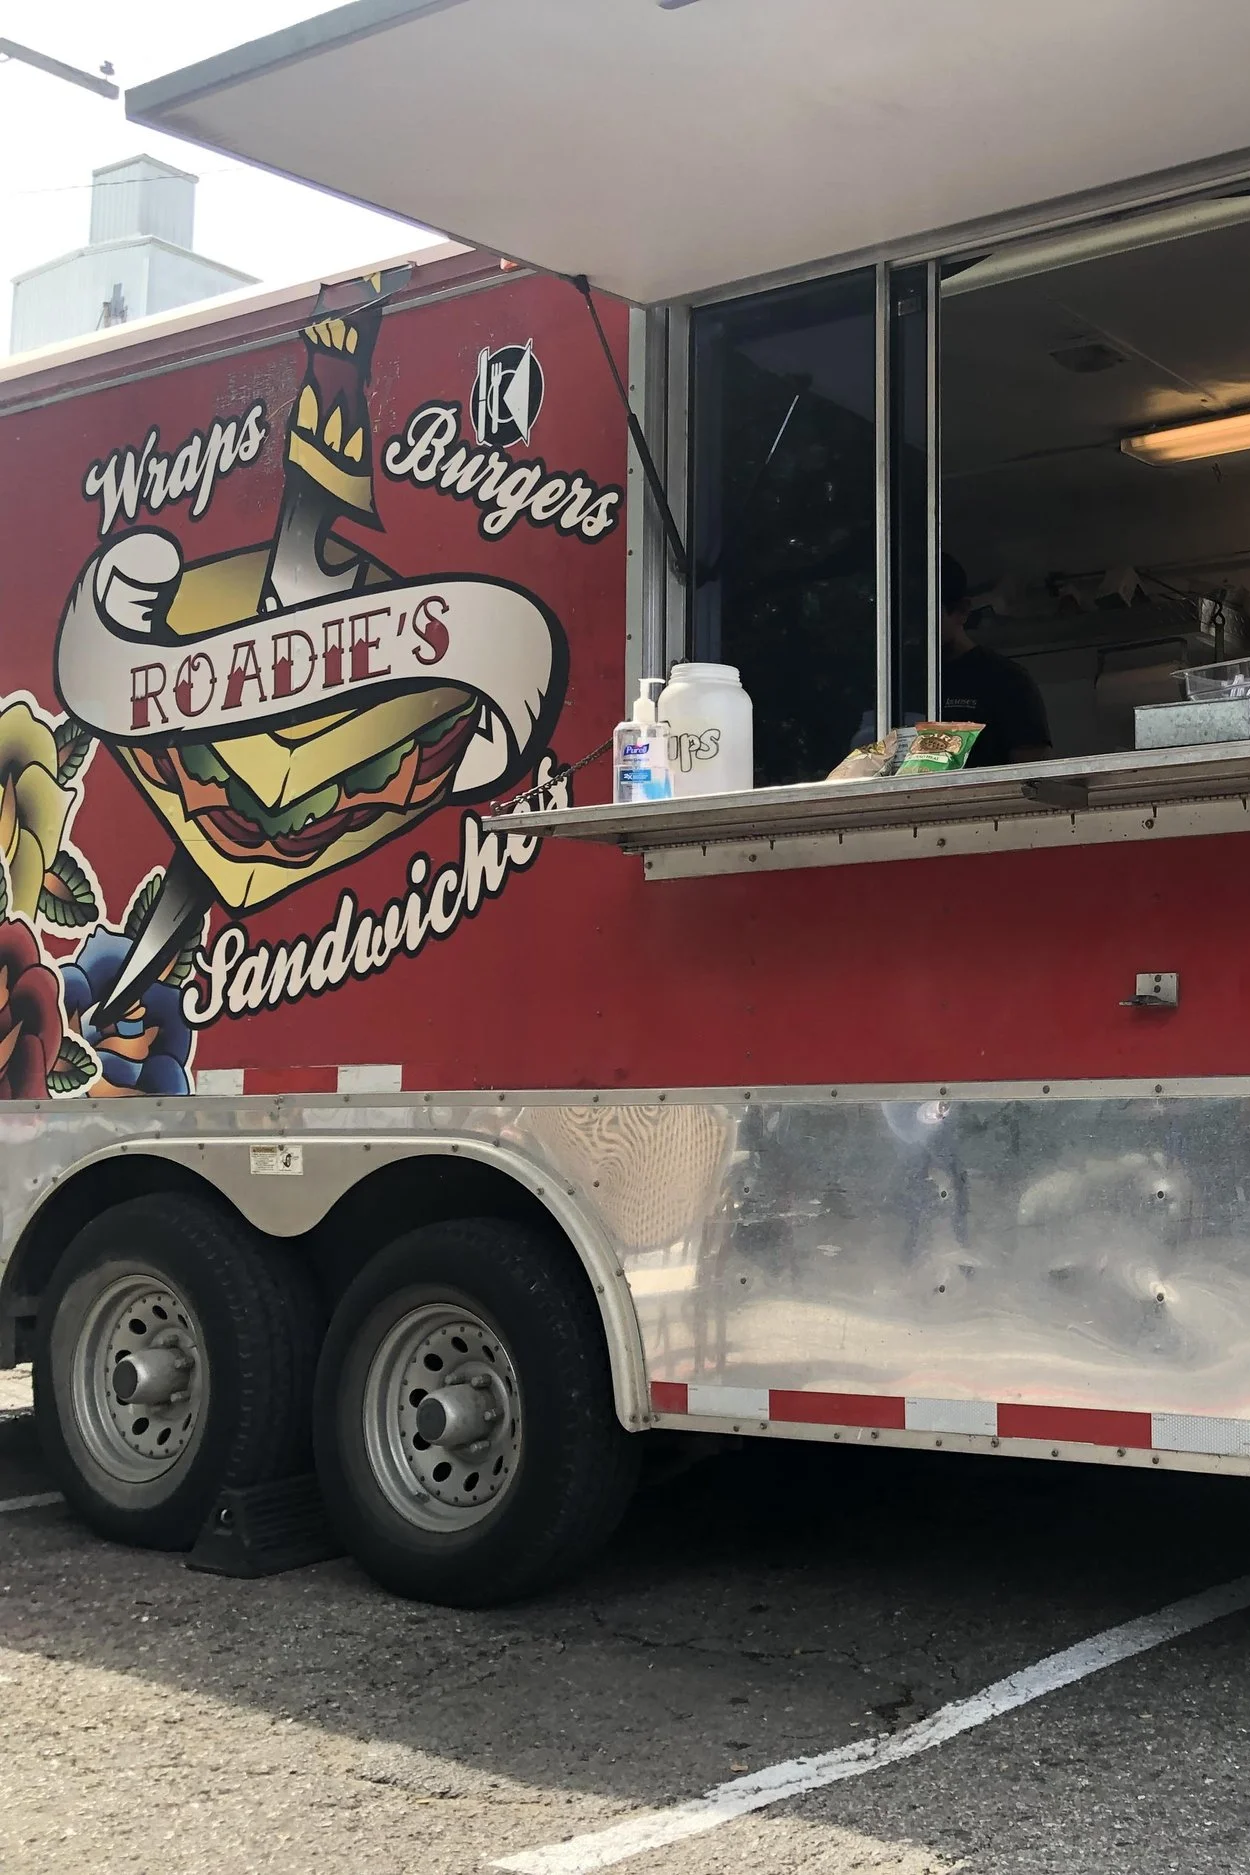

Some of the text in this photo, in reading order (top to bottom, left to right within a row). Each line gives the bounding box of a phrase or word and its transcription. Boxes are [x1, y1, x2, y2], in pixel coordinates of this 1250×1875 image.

[84, 404, 267, 536] Wraps
[384, 406, 620, 537] Burgers
[129, 594, 451, 731] ROADIE'S
[660, 719, 721, 773] ips
